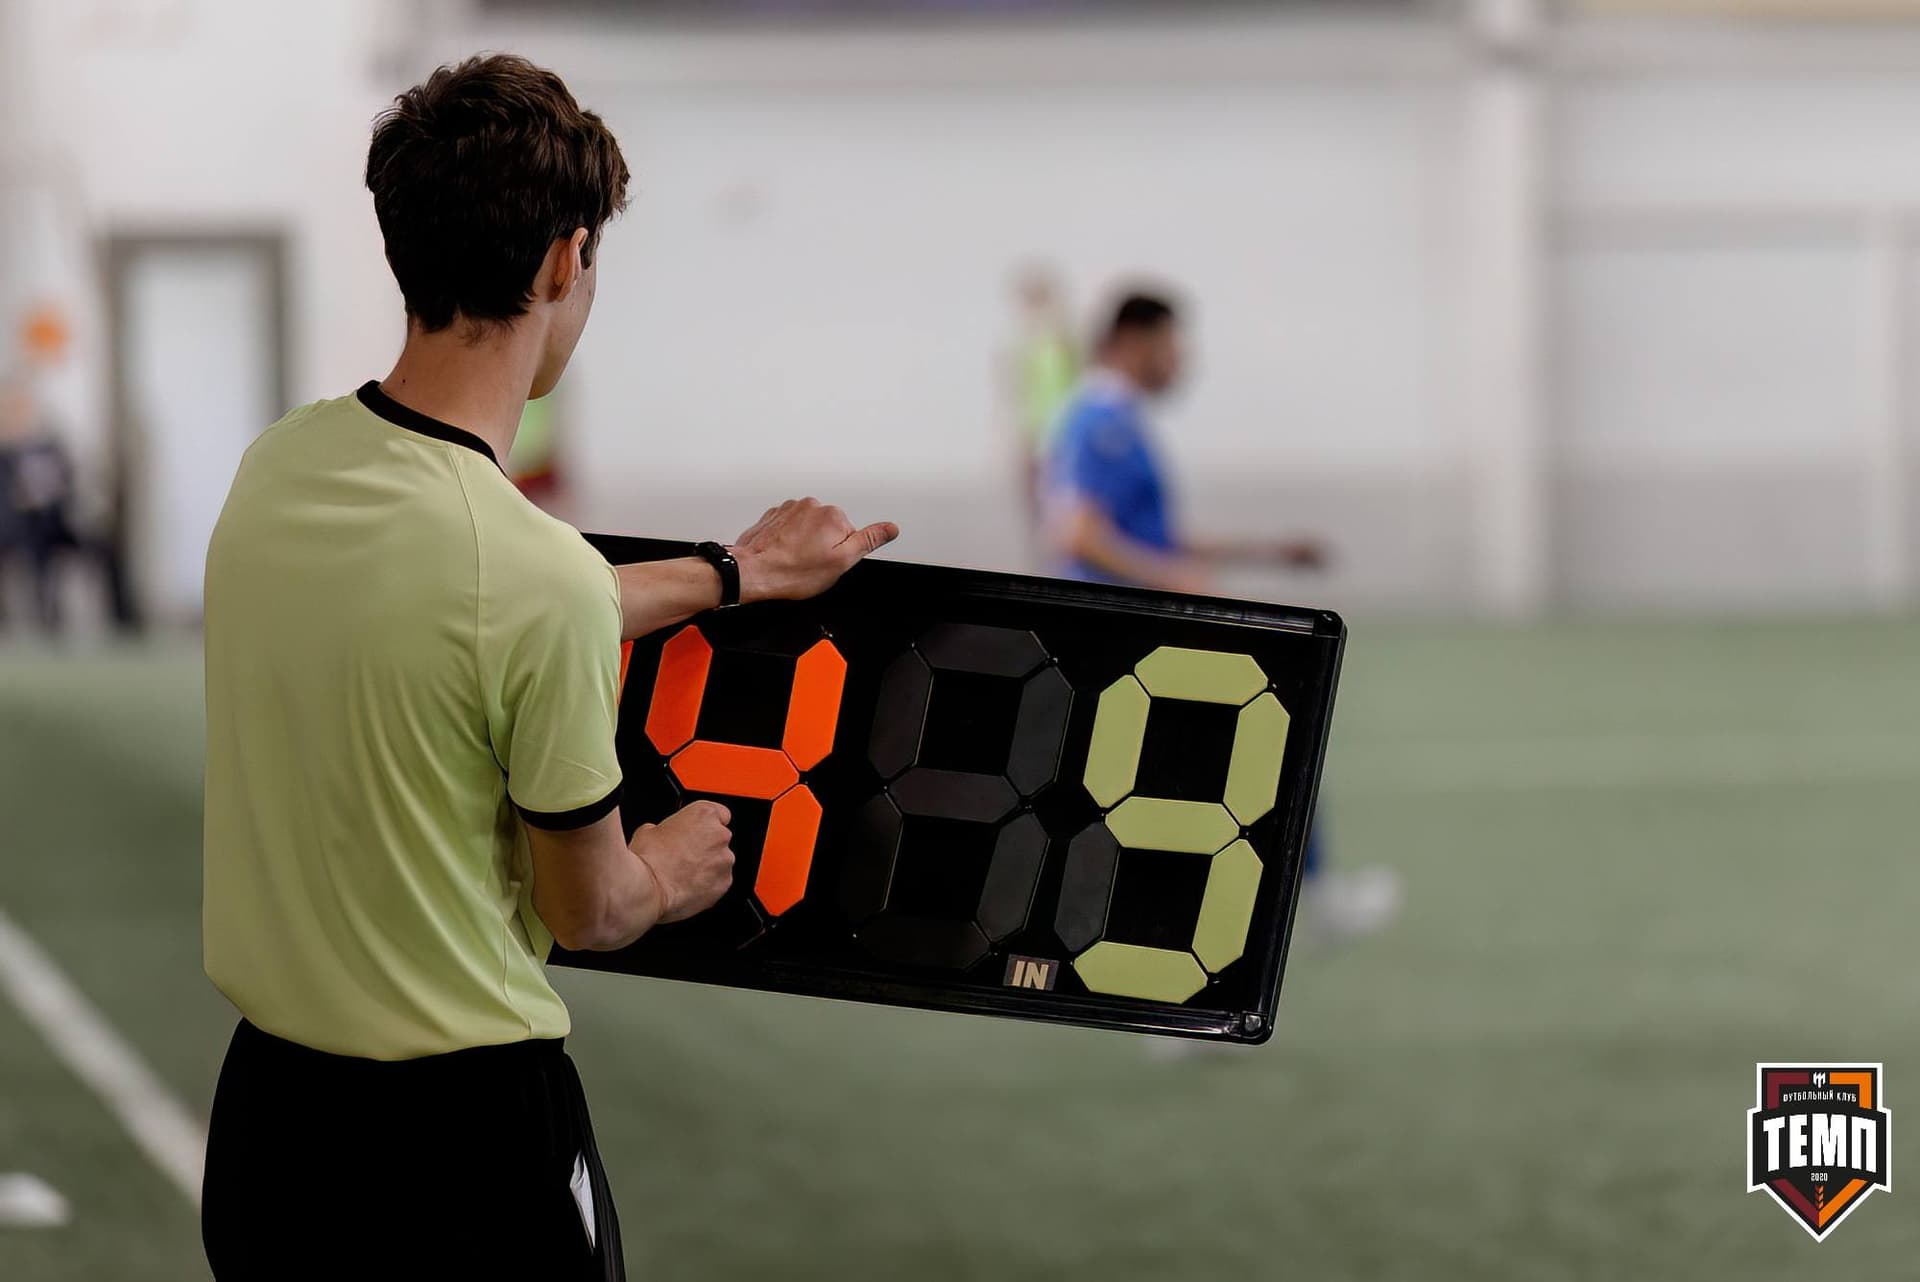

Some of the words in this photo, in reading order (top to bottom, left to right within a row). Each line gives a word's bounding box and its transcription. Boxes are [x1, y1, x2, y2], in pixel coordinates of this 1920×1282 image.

[618, 625, 847, 917] 4
[1073, 646, 1290, 1004] 9
[1012, 960, 1049, 990] IN
